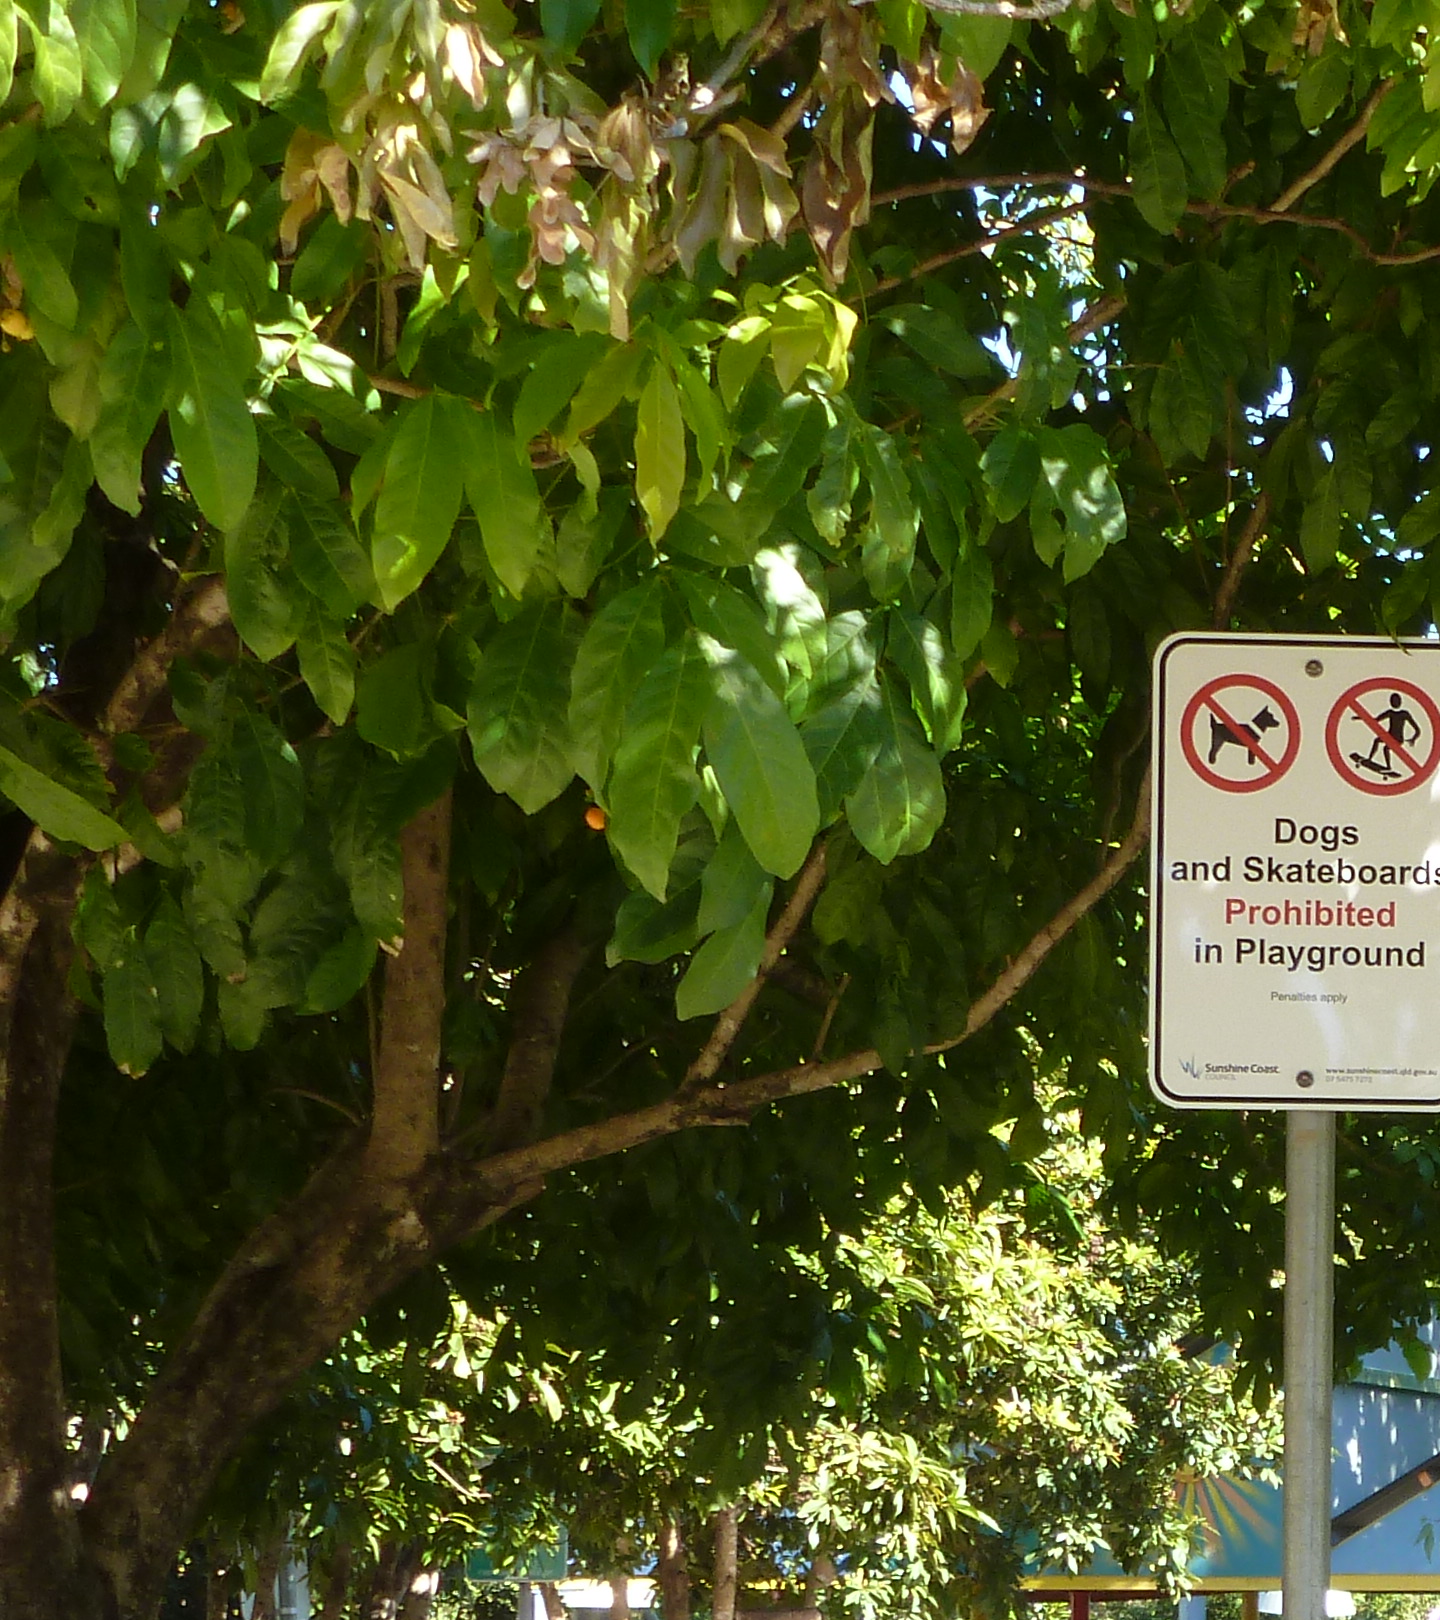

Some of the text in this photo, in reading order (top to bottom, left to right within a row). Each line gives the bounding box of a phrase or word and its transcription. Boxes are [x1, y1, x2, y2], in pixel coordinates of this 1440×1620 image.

[1274, 818, 1360, 851] Dogs
[1171, 857, 1231, 882] and
[1225, 898, 1397, 928] Prohibited
[1195, 938, 1426, 972] in Playground
[1271, 991, 1348, 1005] Penalties apply
[1205, 1063, 1280, 1074] Sunshine Coast
